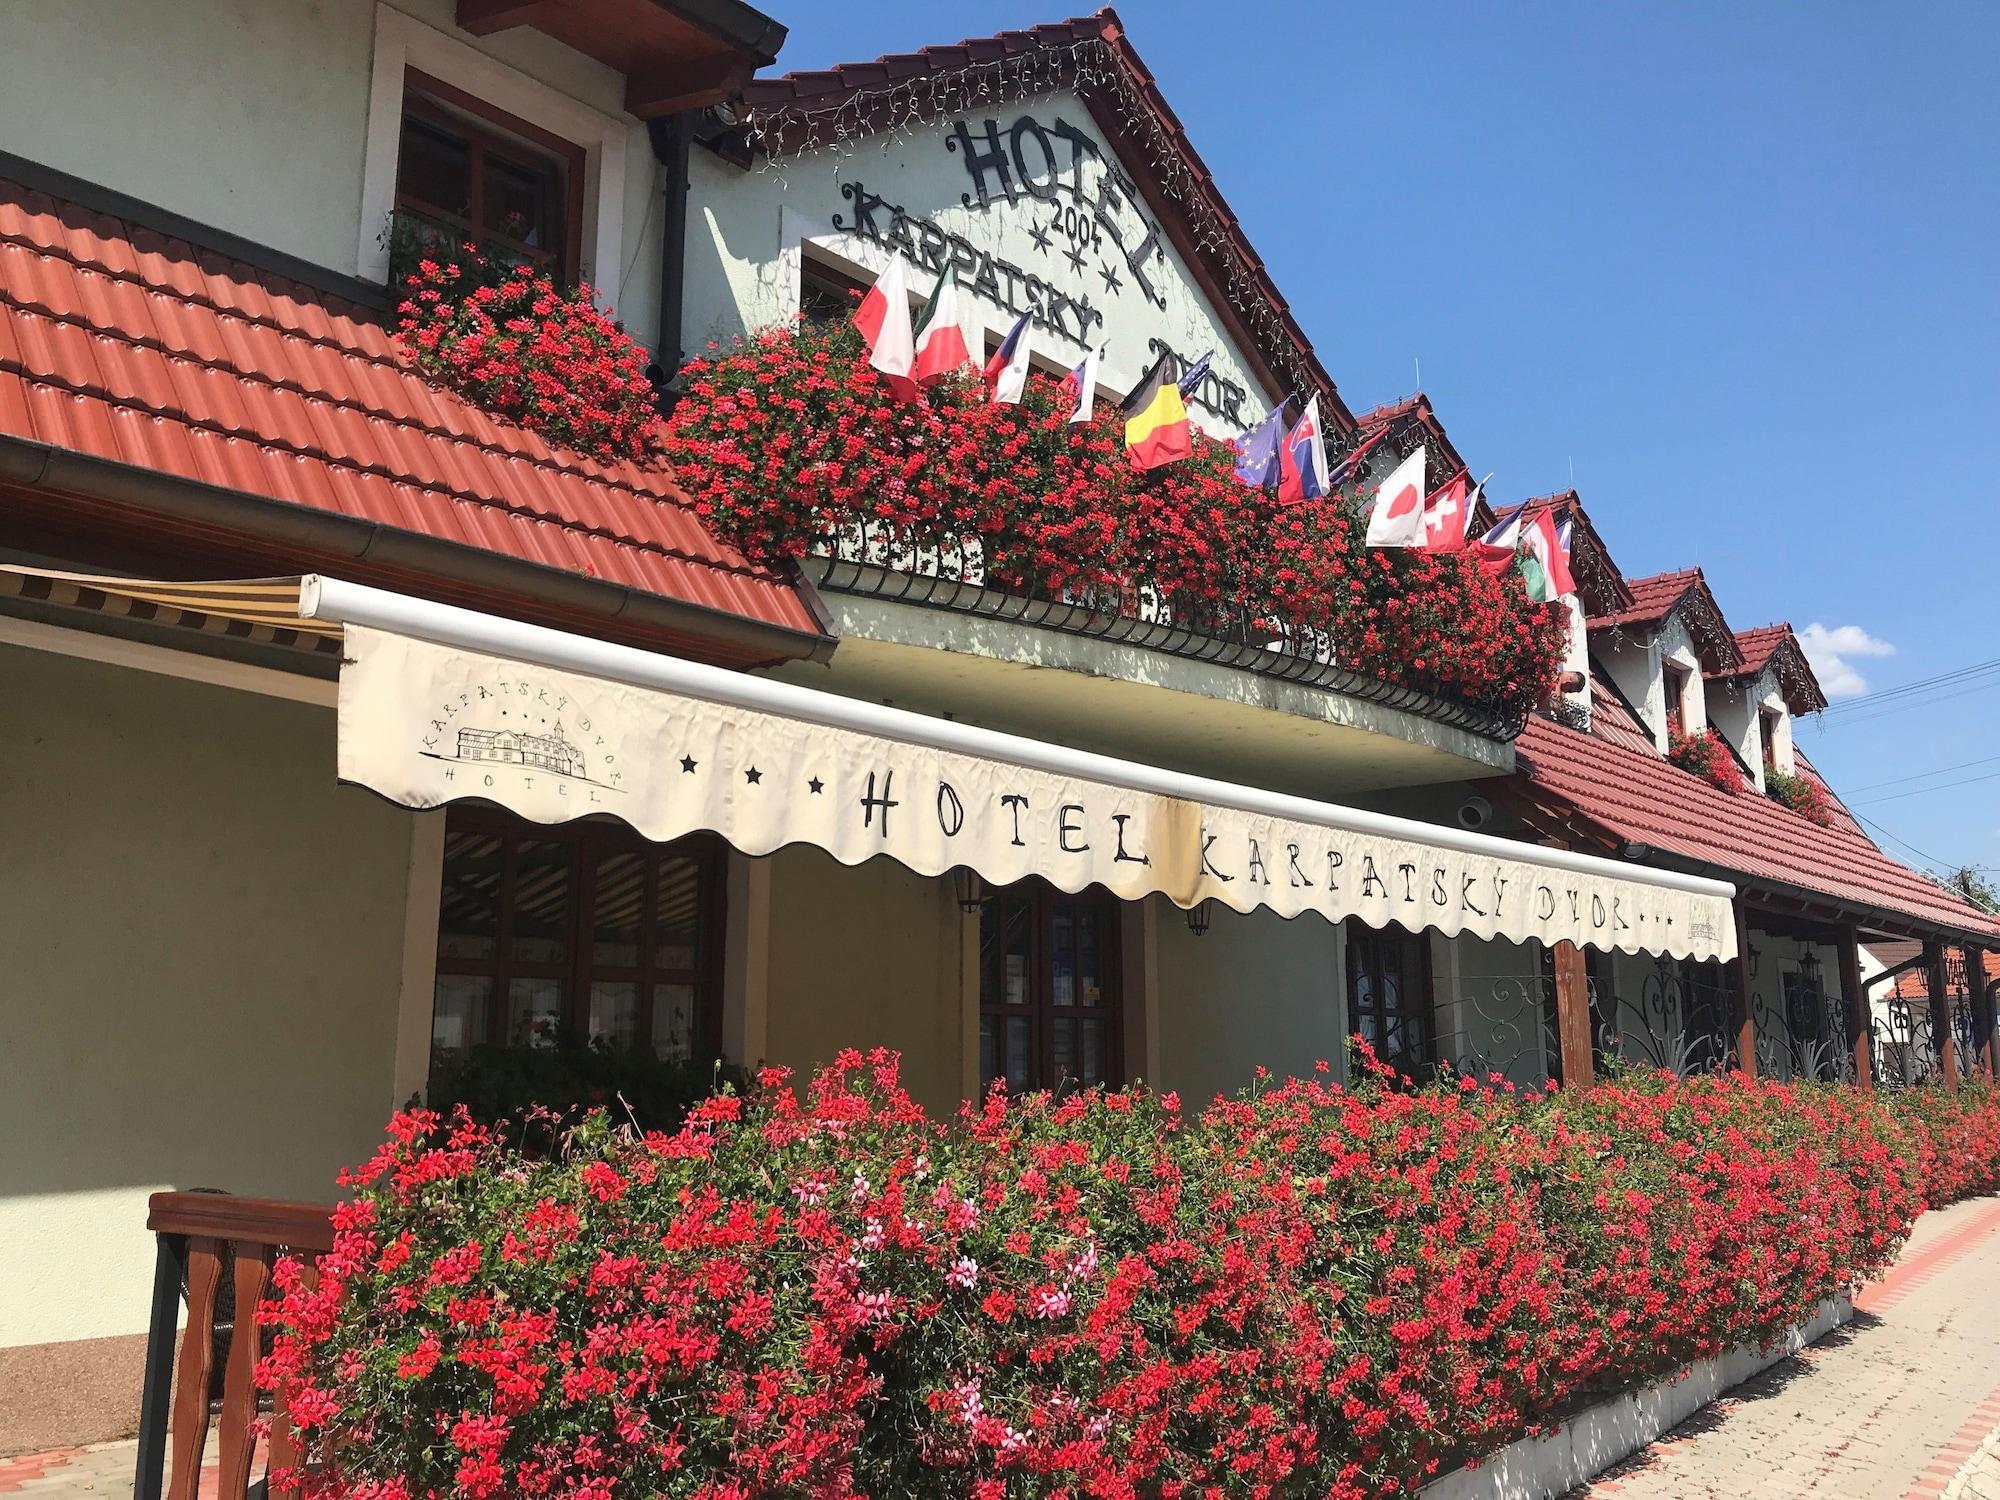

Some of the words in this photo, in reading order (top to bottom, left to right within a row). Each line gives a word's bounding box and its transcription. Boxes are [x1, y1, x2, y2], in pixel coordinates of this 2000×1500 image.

[950, 115, 1165, 304] HOTEL
[1049, 198, 1101, 256] 2004
[445, 767, 600, 803] HOTEL
[578, 718, 621, 785] DVOR
[861, 770, 1151, 868] HOTEL
[1537, 885, 1630, 931] DVOR
